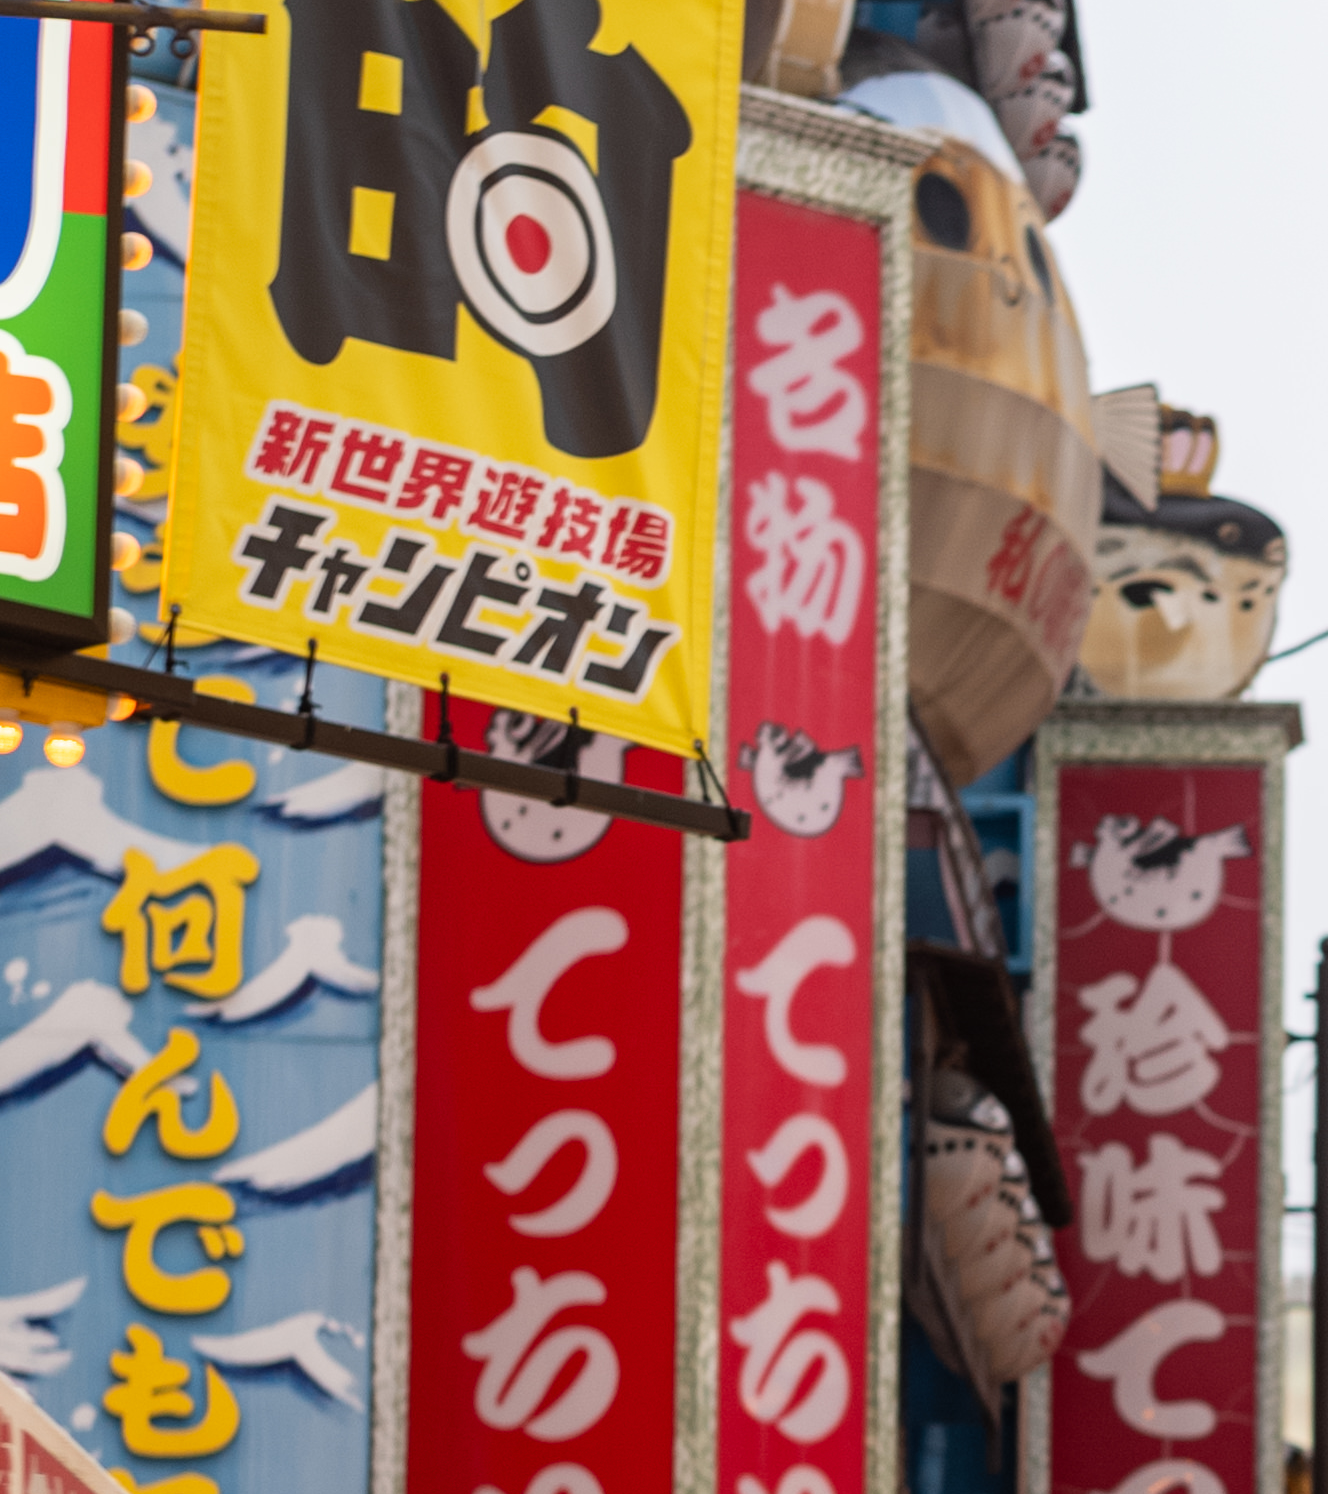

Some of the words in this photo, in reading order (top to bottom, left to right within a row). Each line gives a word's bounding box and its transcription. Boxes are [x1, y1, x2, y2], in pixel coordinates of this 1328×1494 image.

[252, 408, 669, 582] 新世界遊技場
[240, 504, 672, 696] チャンピオン
